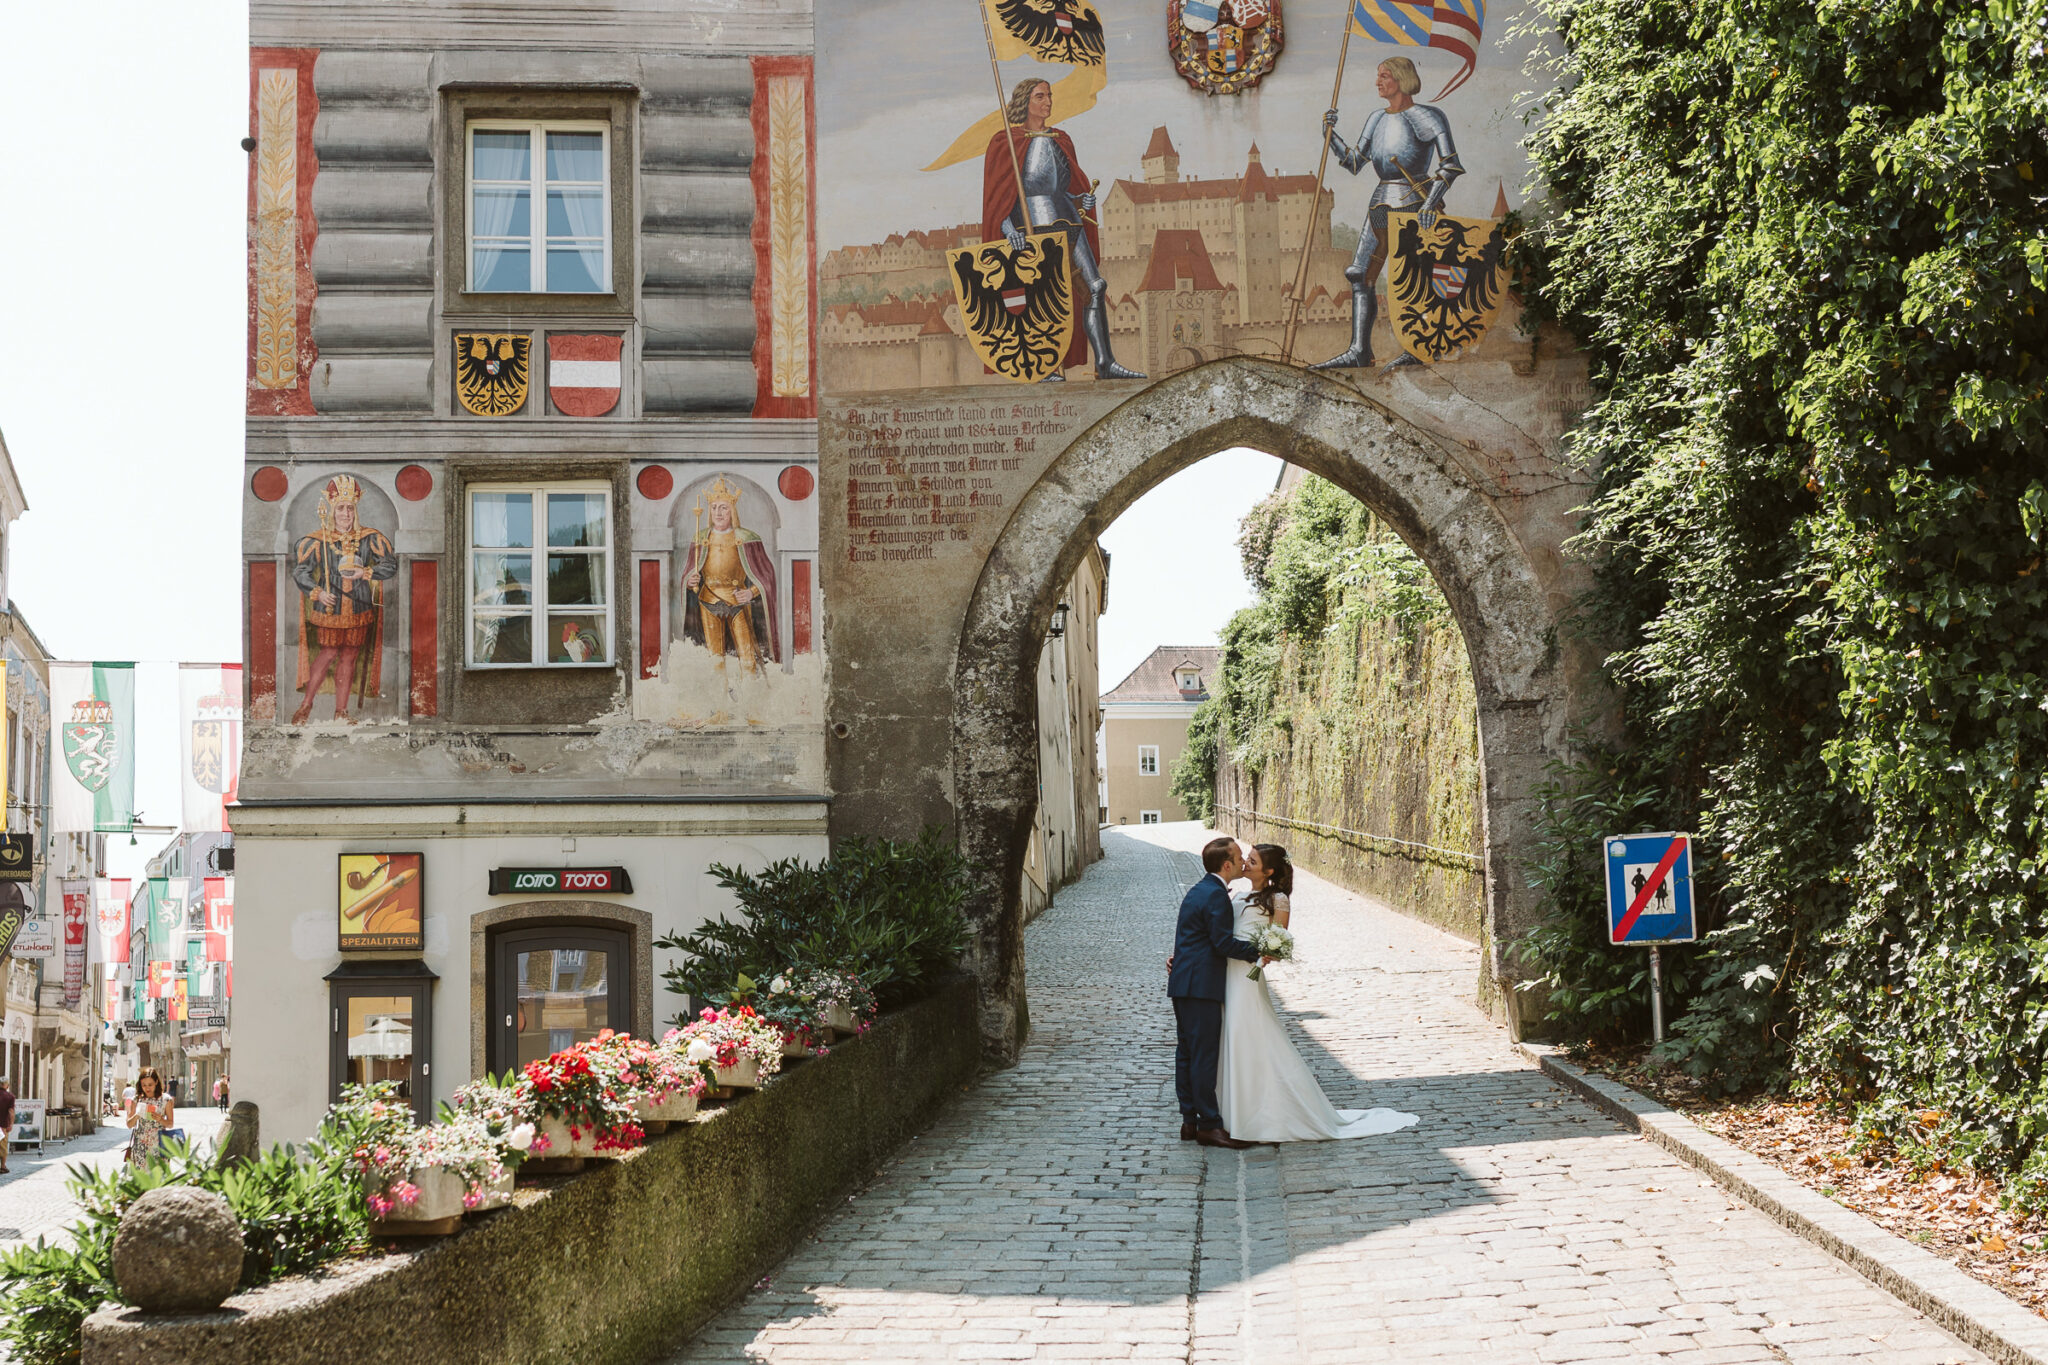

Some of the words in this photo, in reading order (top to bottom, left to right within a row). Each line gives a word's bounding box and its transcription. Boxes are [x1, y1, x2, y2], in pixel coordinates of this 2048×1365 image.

[847, 409, 866, 424] An
[871, 410, 889, 424] der
[990, 406, 1006, 419] ein
[872, 427, 902, 440] 1489
[905, 426, 940, 439] erbaut
[944, 424, 964, 438] und
[968, 423, 996, 437] 1864
[997, 424, 1019, 436] aus
[904, 441, 969, 457] abgebrochen
[973, 440, 1009, 454] wurde.
[1013, 437, 1036, 452] Auf
[910, 461, 940, 474] waren
[943, 459, 966, 473] zwei
[969, 456, 998, 471] Ritter
[1002, 456, 1023, 470] mit
[847, 479, 892, 494] Bannern
[895, 478, 917, 492] und
[920, 476, 966, 490] Schilden
[971, 477, 993, 489] von
[884, 494, 930, 509] Friedrich
[945, 495, 966, 508] und
[969, 490, 1003, 507] König
[912, 512, 928, 525] den
[930, 509, 977, 526] Regenten
[849, 532, 866, 546] zur
[868, 529, 945, 545] Erbauungszeit
[950, 528, 968, 541] des
[848, 545, 876, 562] Tores
[515, 873, 557, 888] LOTTO
[565, 873, 608, 888] TOTO
